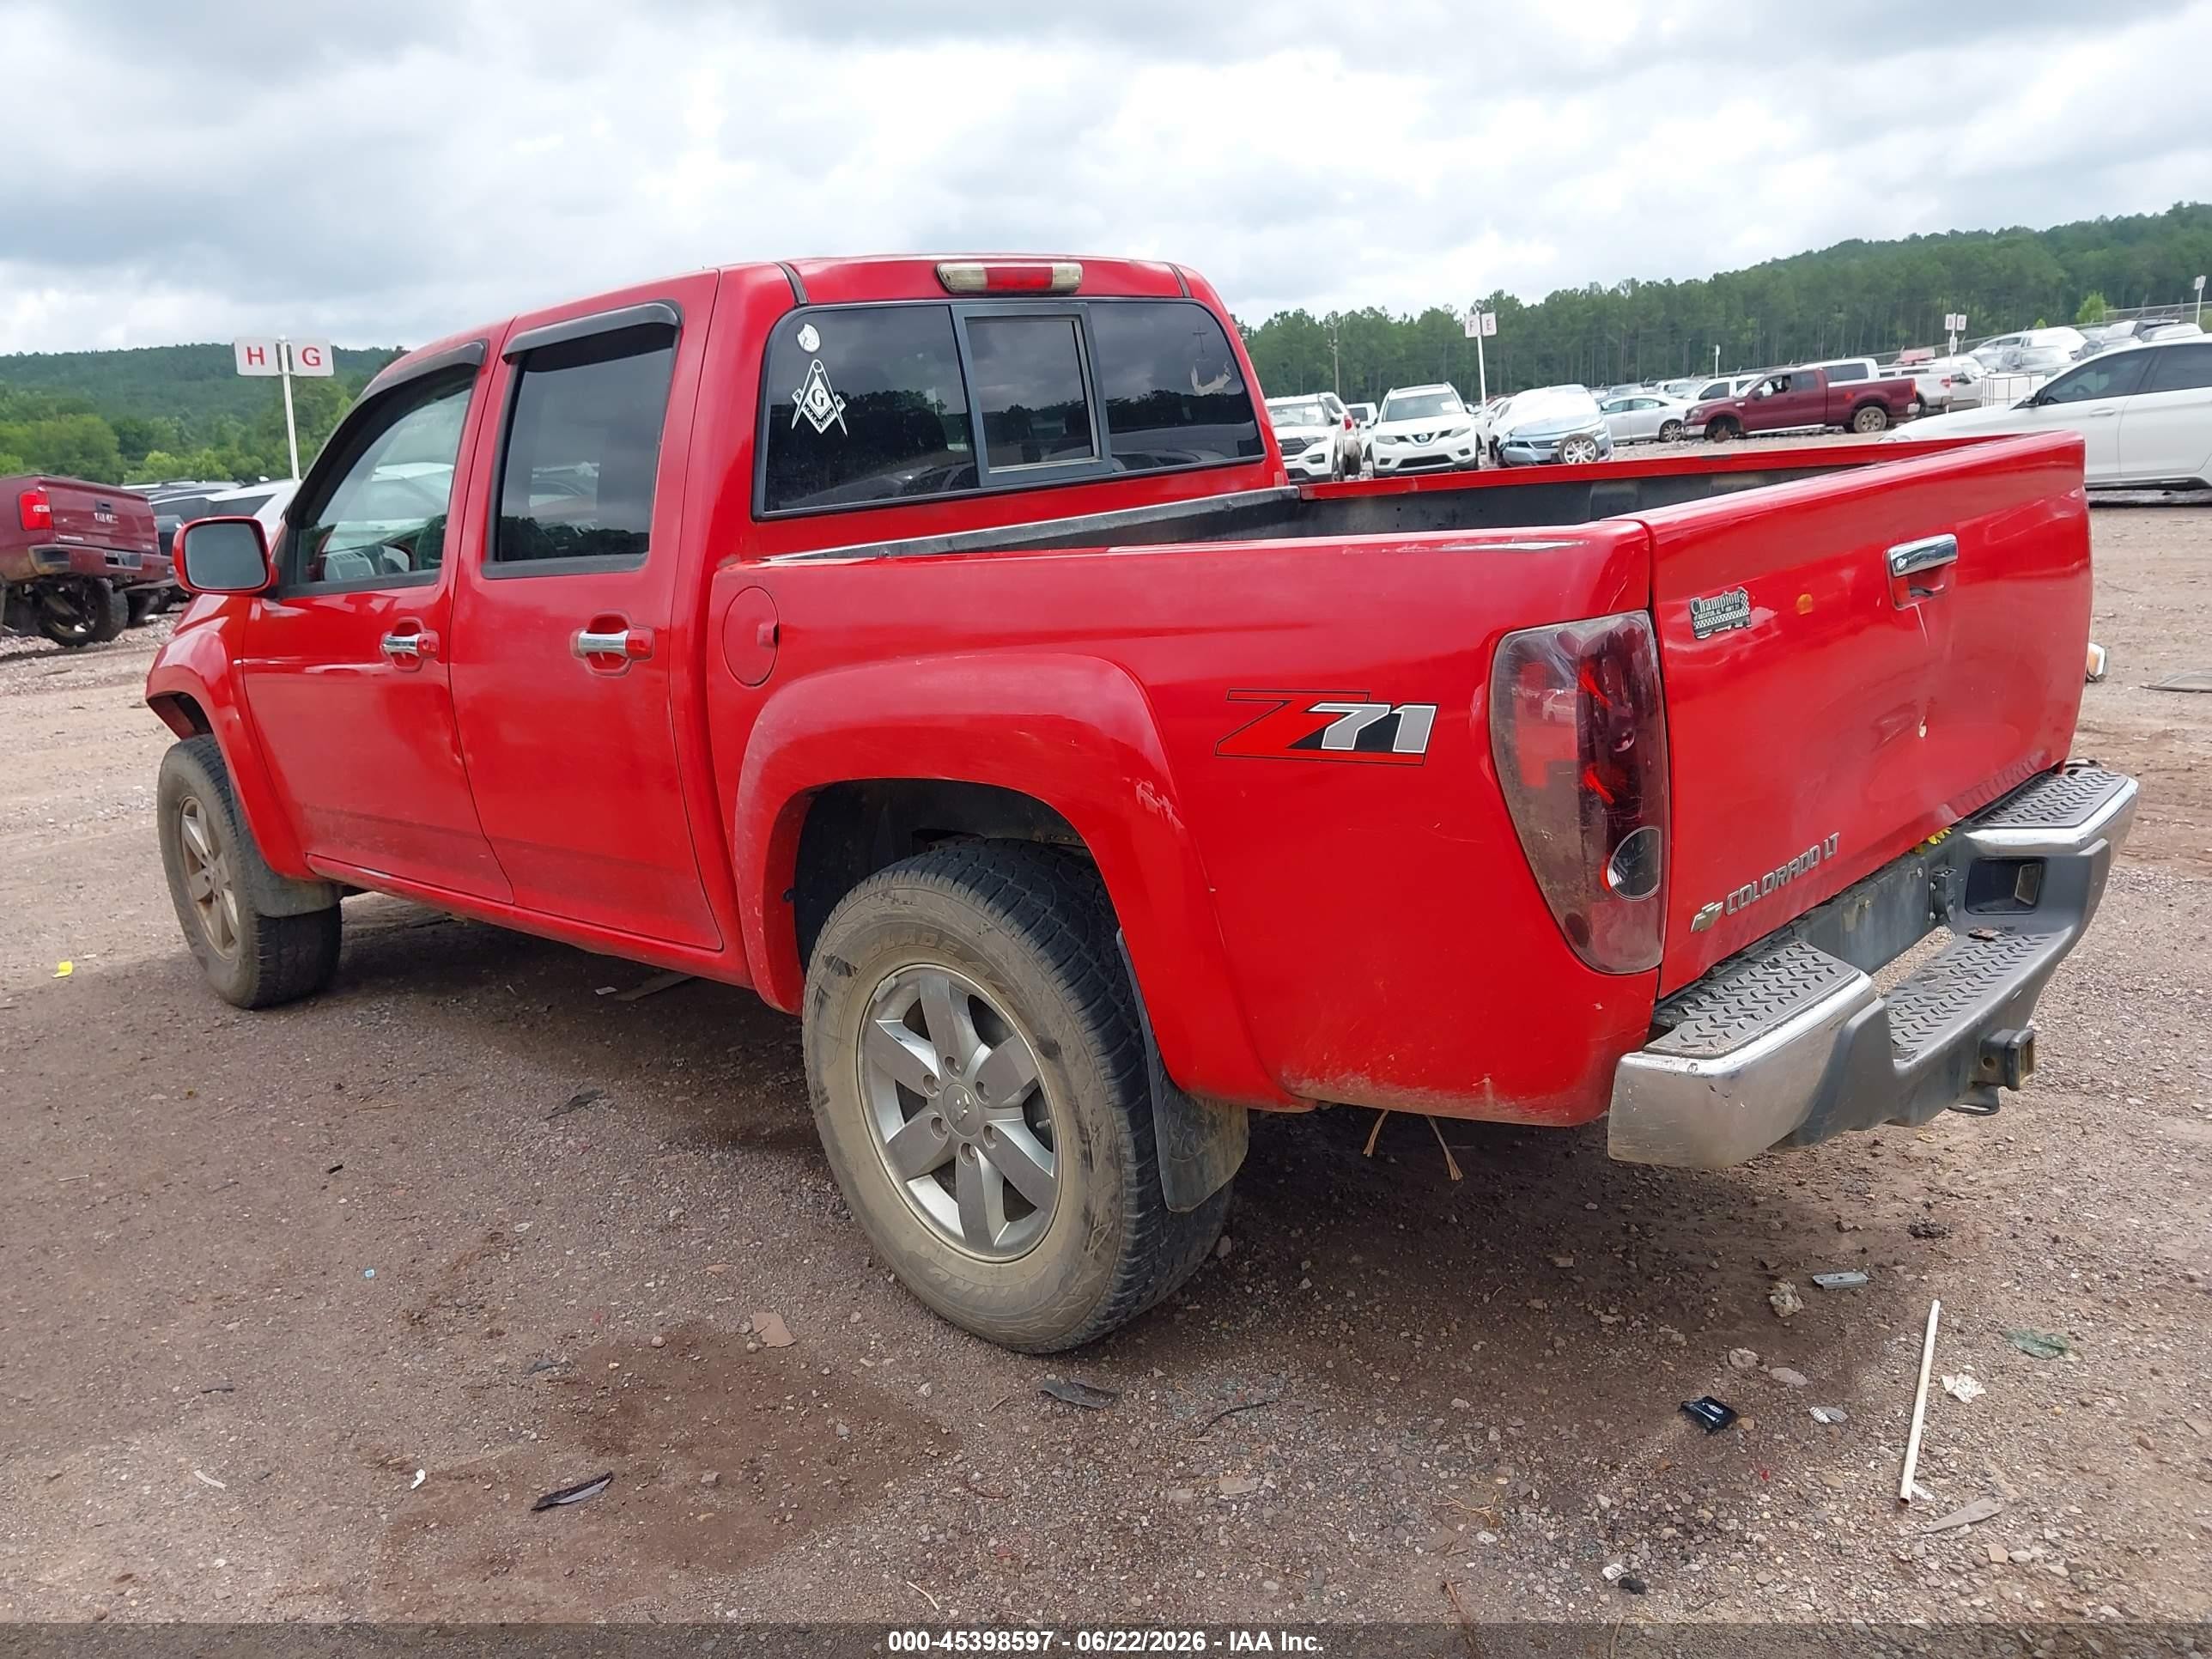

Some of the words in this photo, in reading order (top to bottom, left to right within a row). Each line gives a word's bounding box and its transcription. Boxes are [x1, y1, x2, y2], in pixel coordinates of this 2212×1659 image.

[246, 346, 264, 366] H
[301, 347, 321, 367] G
[811, 388, 824, 408] G
[1214, 688, 1439, 766] Z71
[1725, 844, 1820, 915] COLORADO
[1823, 831, 1840, 860] LT
